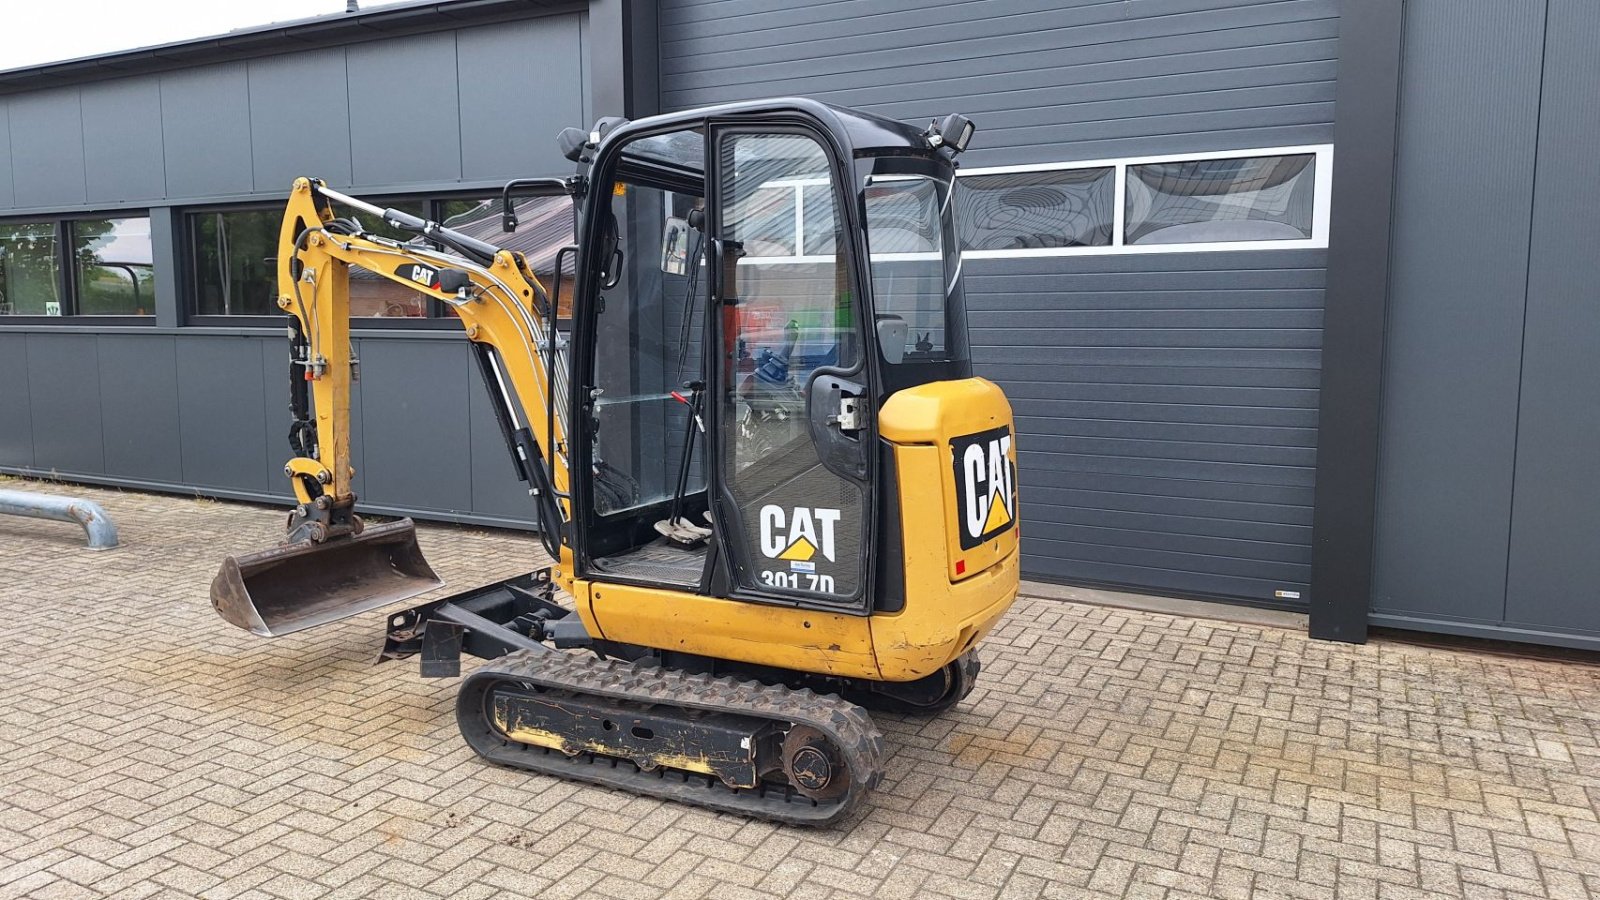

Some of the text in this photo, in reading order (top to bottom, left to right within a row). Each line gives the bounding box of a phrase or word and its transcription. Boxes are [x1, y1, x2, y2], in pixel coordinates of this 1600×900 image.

[411, 265, 434, 286] CAT
[963, 435, 1013, 538] CAT
[760, 504, 841, 563] CAT
